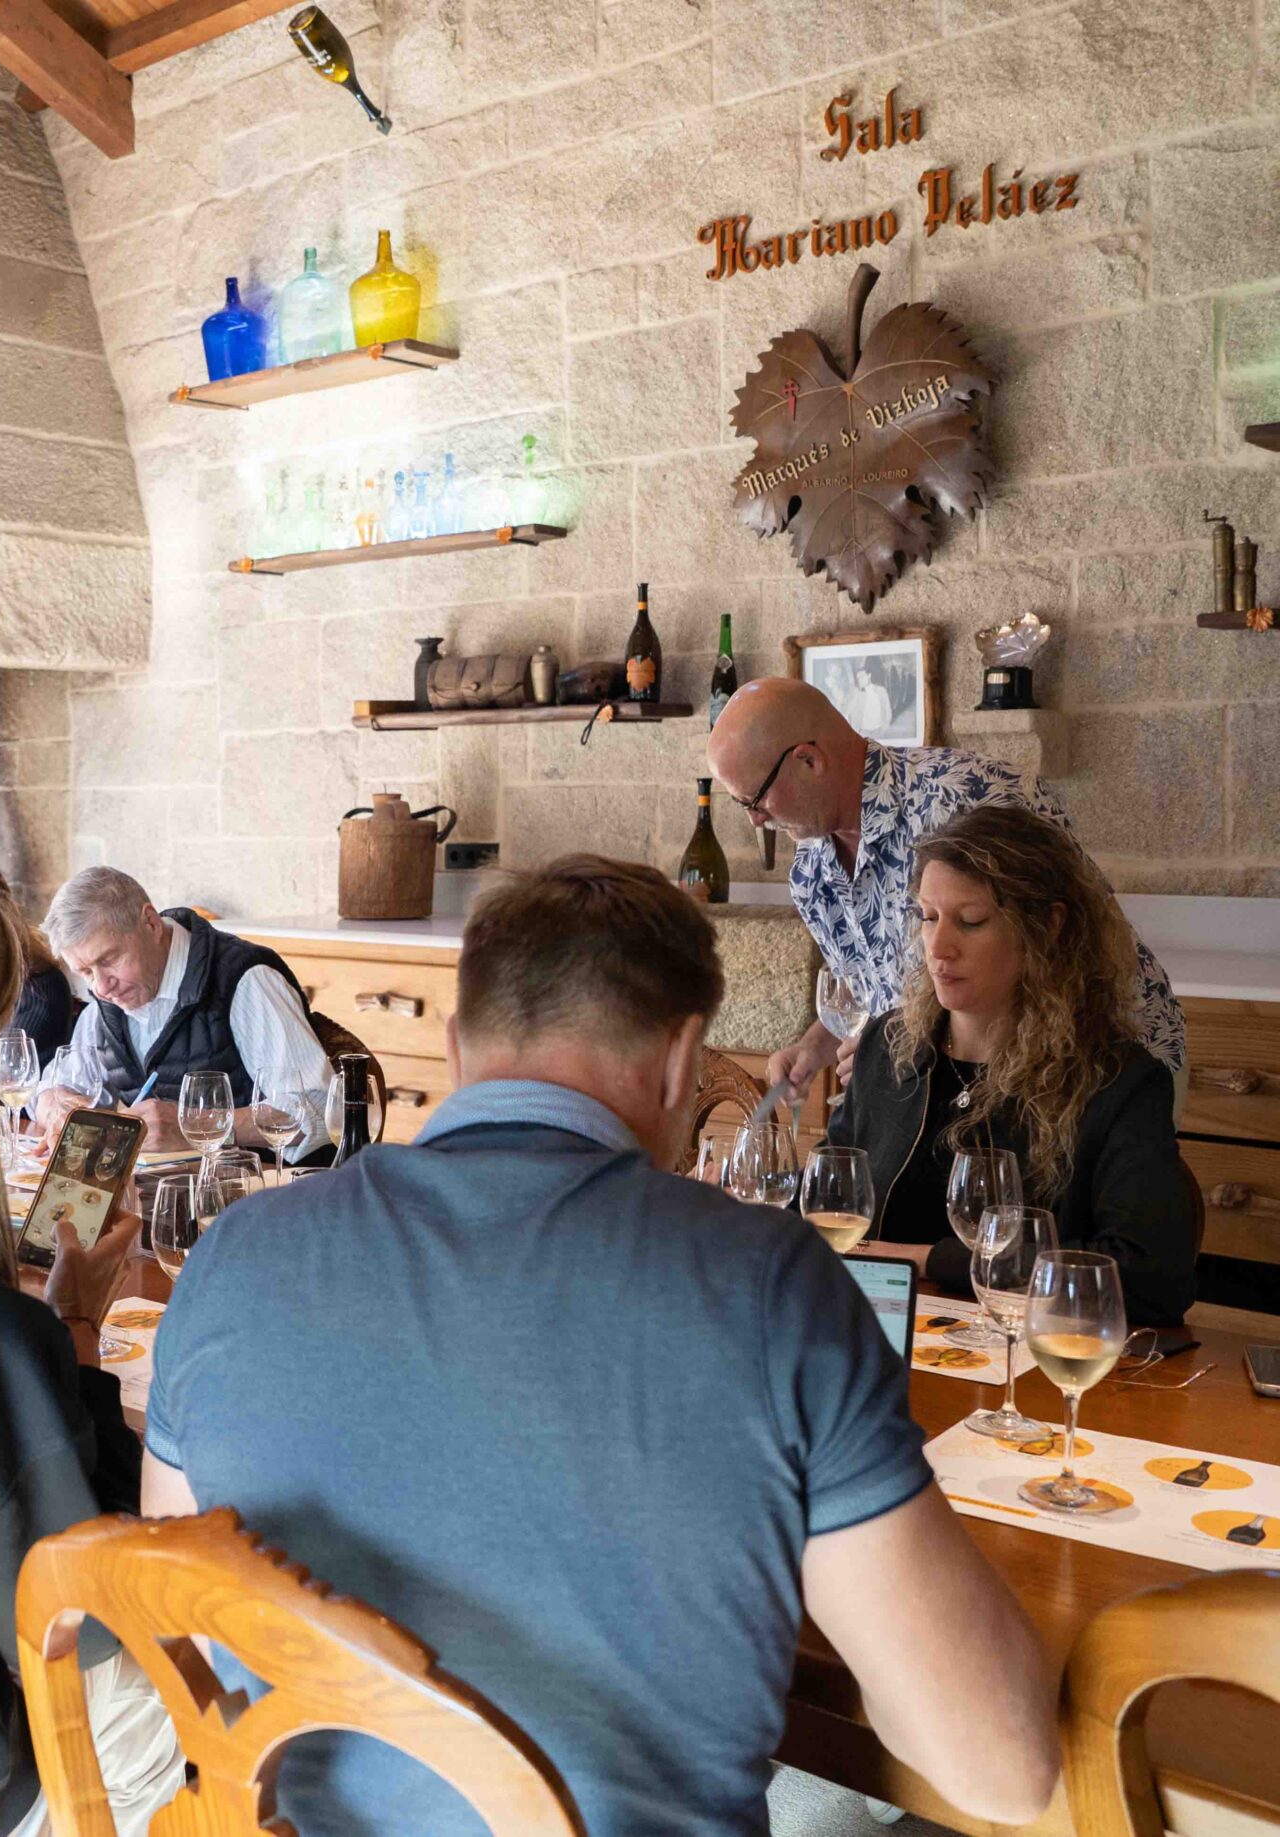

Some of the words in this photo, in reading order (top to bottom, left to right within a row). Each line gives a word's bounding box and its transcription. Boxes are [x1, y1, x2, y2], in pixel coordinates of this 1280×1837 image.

[820, 87, 922, 162] Sala
[696, 210, 898, 281] Mariano
[917, 162, 1079, 238] Peláez
[742, 443, 829, 500] Marqués
[839, 427, 861, 448] de
[866, 374, 951, 429] Vizhoja
[863, 468, 909, 484] LOUREIRO
